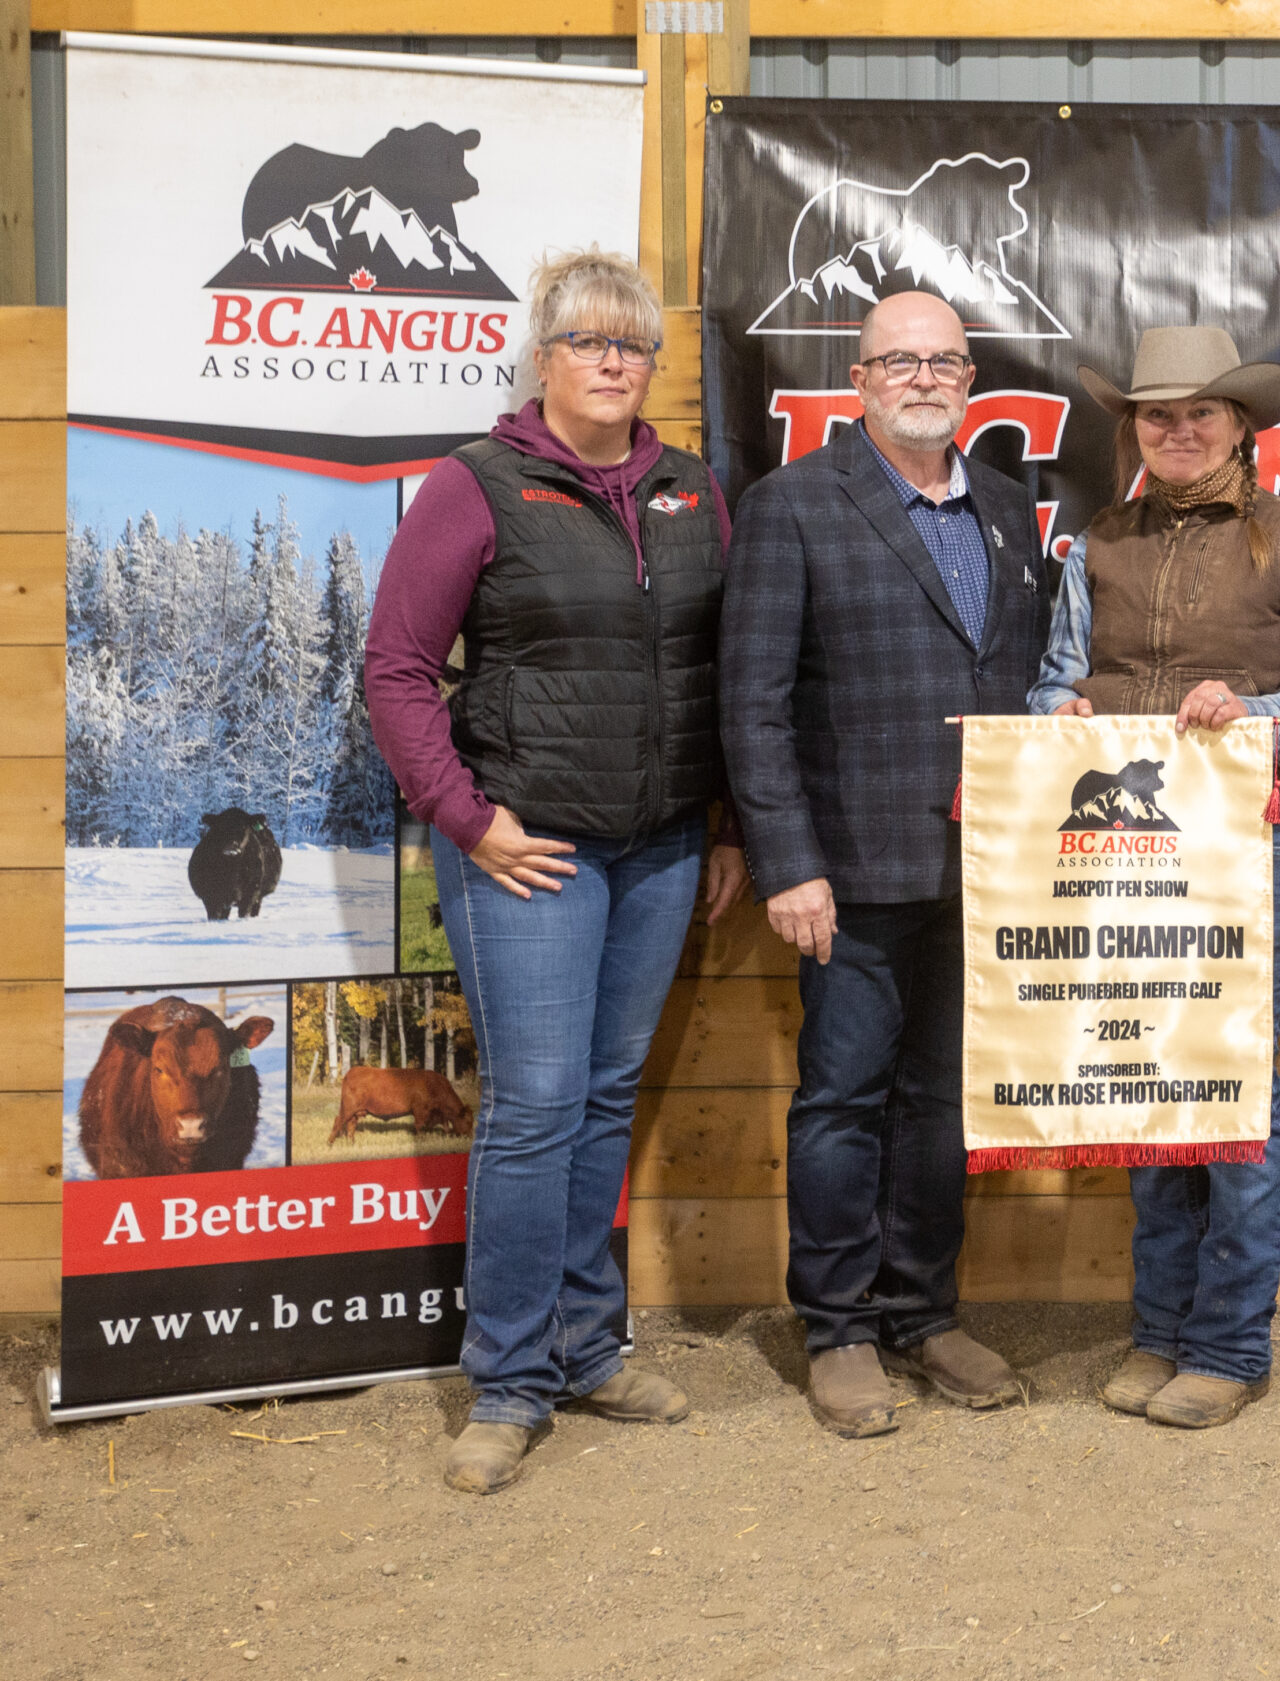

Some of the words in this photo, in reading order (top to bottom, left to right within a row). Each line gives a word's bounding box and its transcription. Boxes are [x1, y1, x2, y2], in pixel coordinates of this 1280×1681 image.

[205, 294, 307, 347] B.C.
[315, 306, 508, 354] ANGUS
[200, 355, 516, 387] ASSOCIATION
[1058, 832, 1099, 854] B.C.
[1101, 836, 1177, 855] ANGUS
[1056, 857, 1182, 868] ASSOCIATION
[1052, 880, 1114, 898] JACKPOT
[1116, 880, 1142, 897] PEN
[1144, 880, 1188, 897] SHOW
[996, 926, 1091, 960] GRAND
[1097, 925, 1244, 959] CHAMPION
[1018, 984, 1066, 1001] SINGLE
[1068, 982, 1139, 1000] PUREBRED
[1141, 982, 1187, 999] HEIFER
[1189, 982, 1223, 999] CALF
[1097, 1019, 1141, 1041] 2024
[1078, 1063, 1142, 1078] SPONSORED
[1143, 1062, 1161, 1077] BY:
[994, 1083, 1056, 1106] BLACK
[1058, 1082, 1106, 1106] ROSE
[1109, 1080, 1243, 1104] PHOTOGRAPHY
[103, 1202, 146, 1245] A
[161, 1194, 336, 1241] Better
[350, 1183, 452, 1231] Buy
